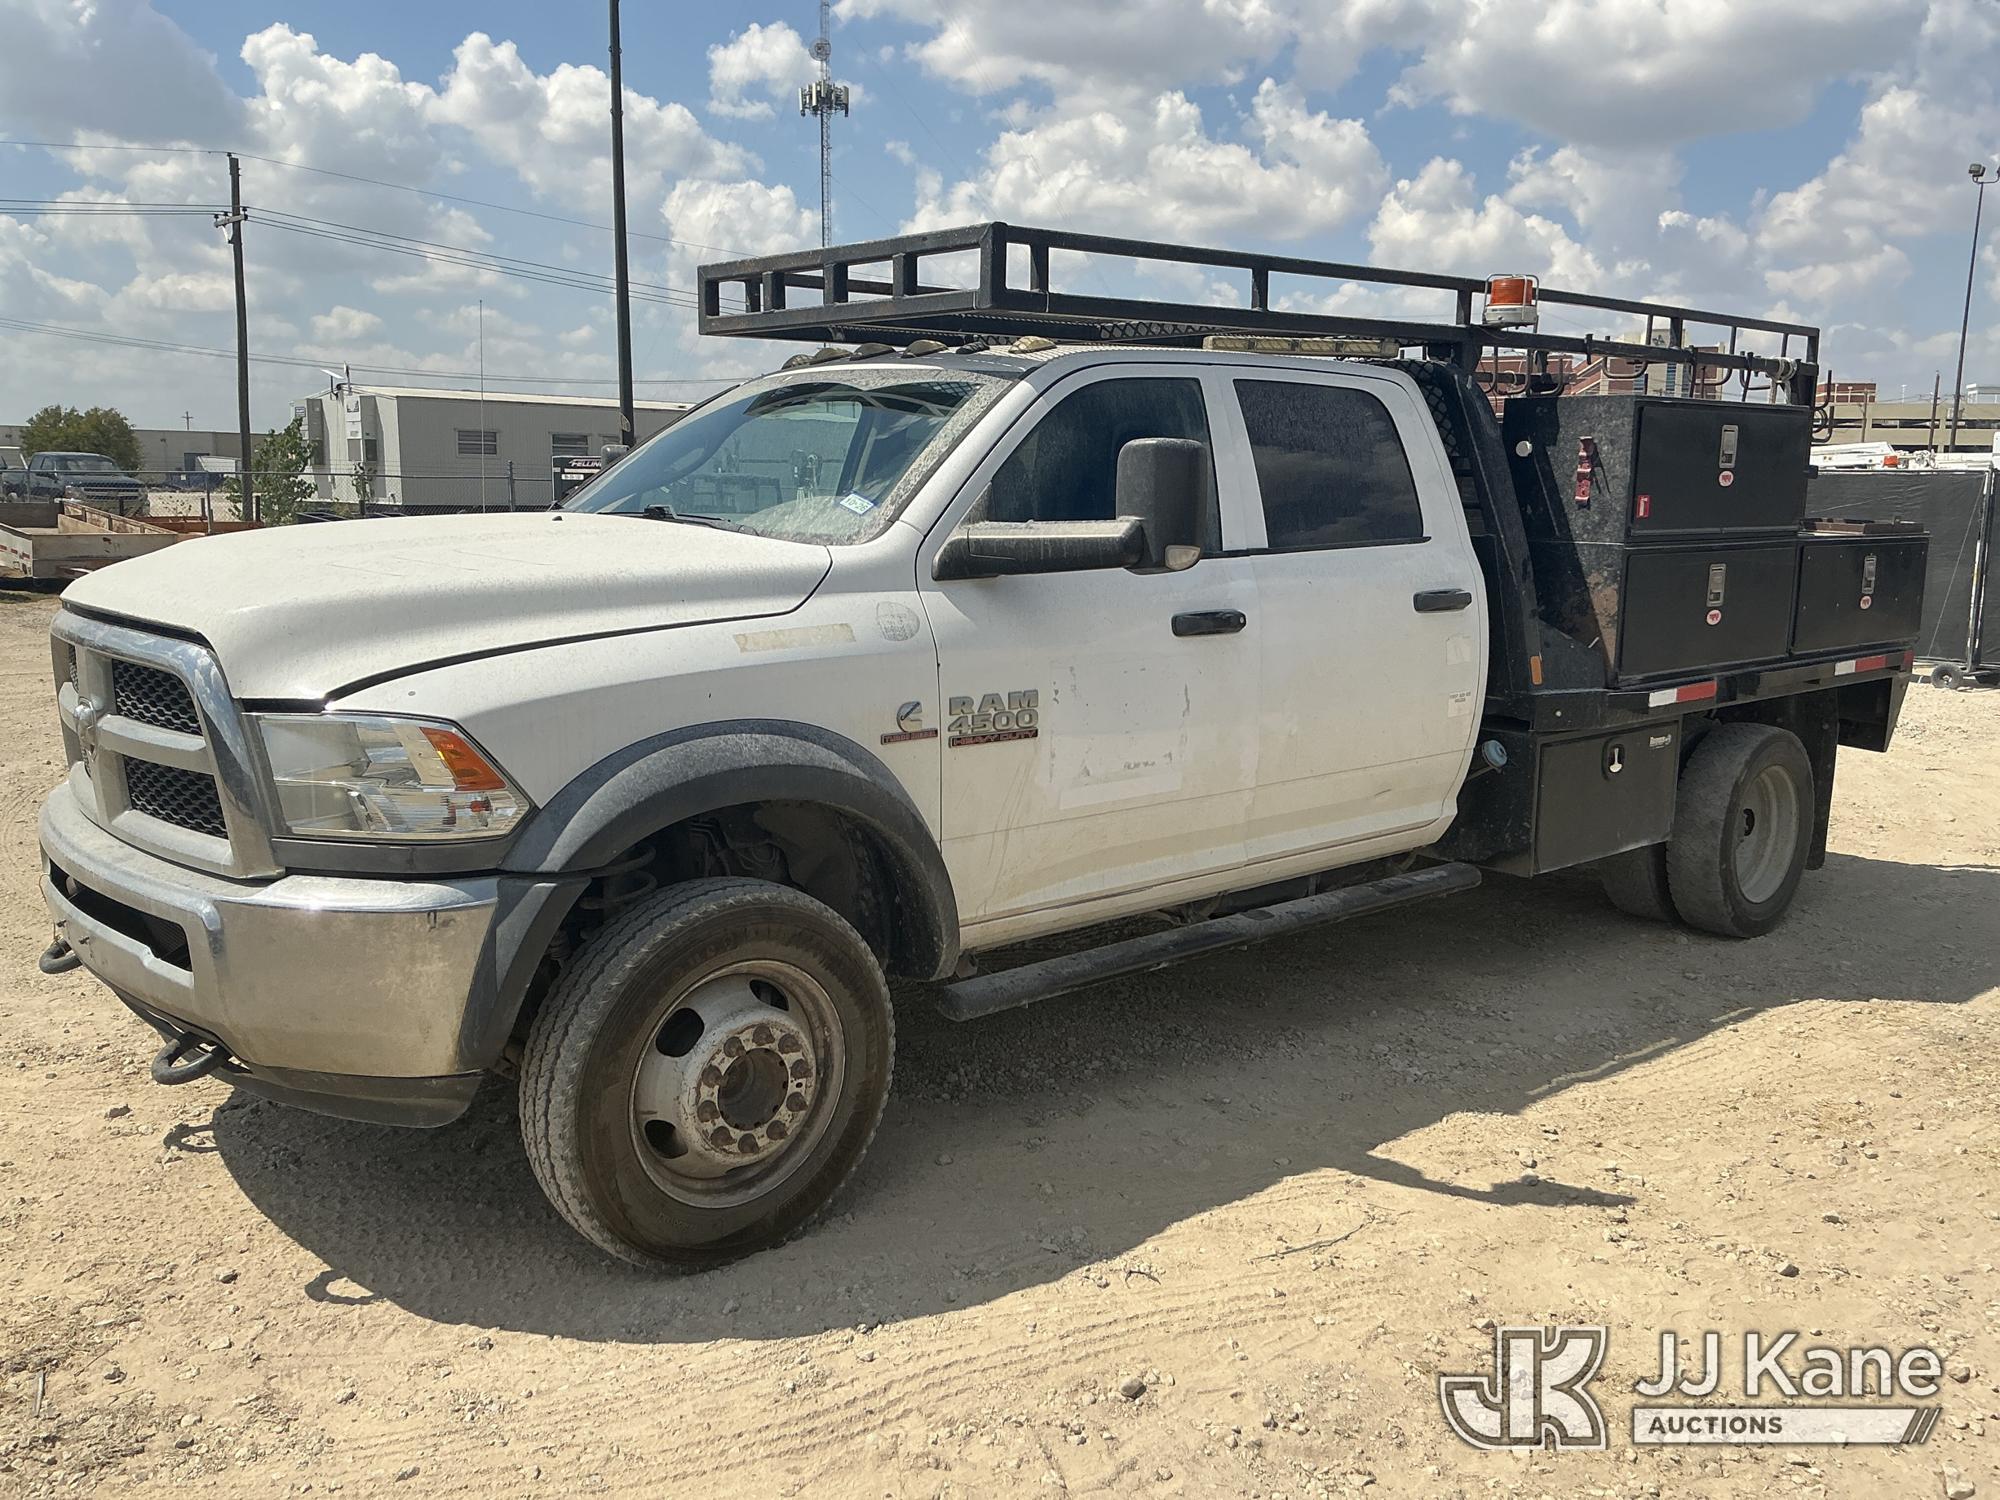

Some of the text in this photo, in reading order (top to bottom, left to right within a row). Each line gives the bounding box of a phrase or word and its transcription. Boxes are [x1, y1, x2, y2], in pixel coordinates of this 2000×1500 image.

[949, 690, 1039, 716] RAM
[948, 709, 1039, 735] 4500
[953, 730, 1036, 746] HEAVY DUTY
